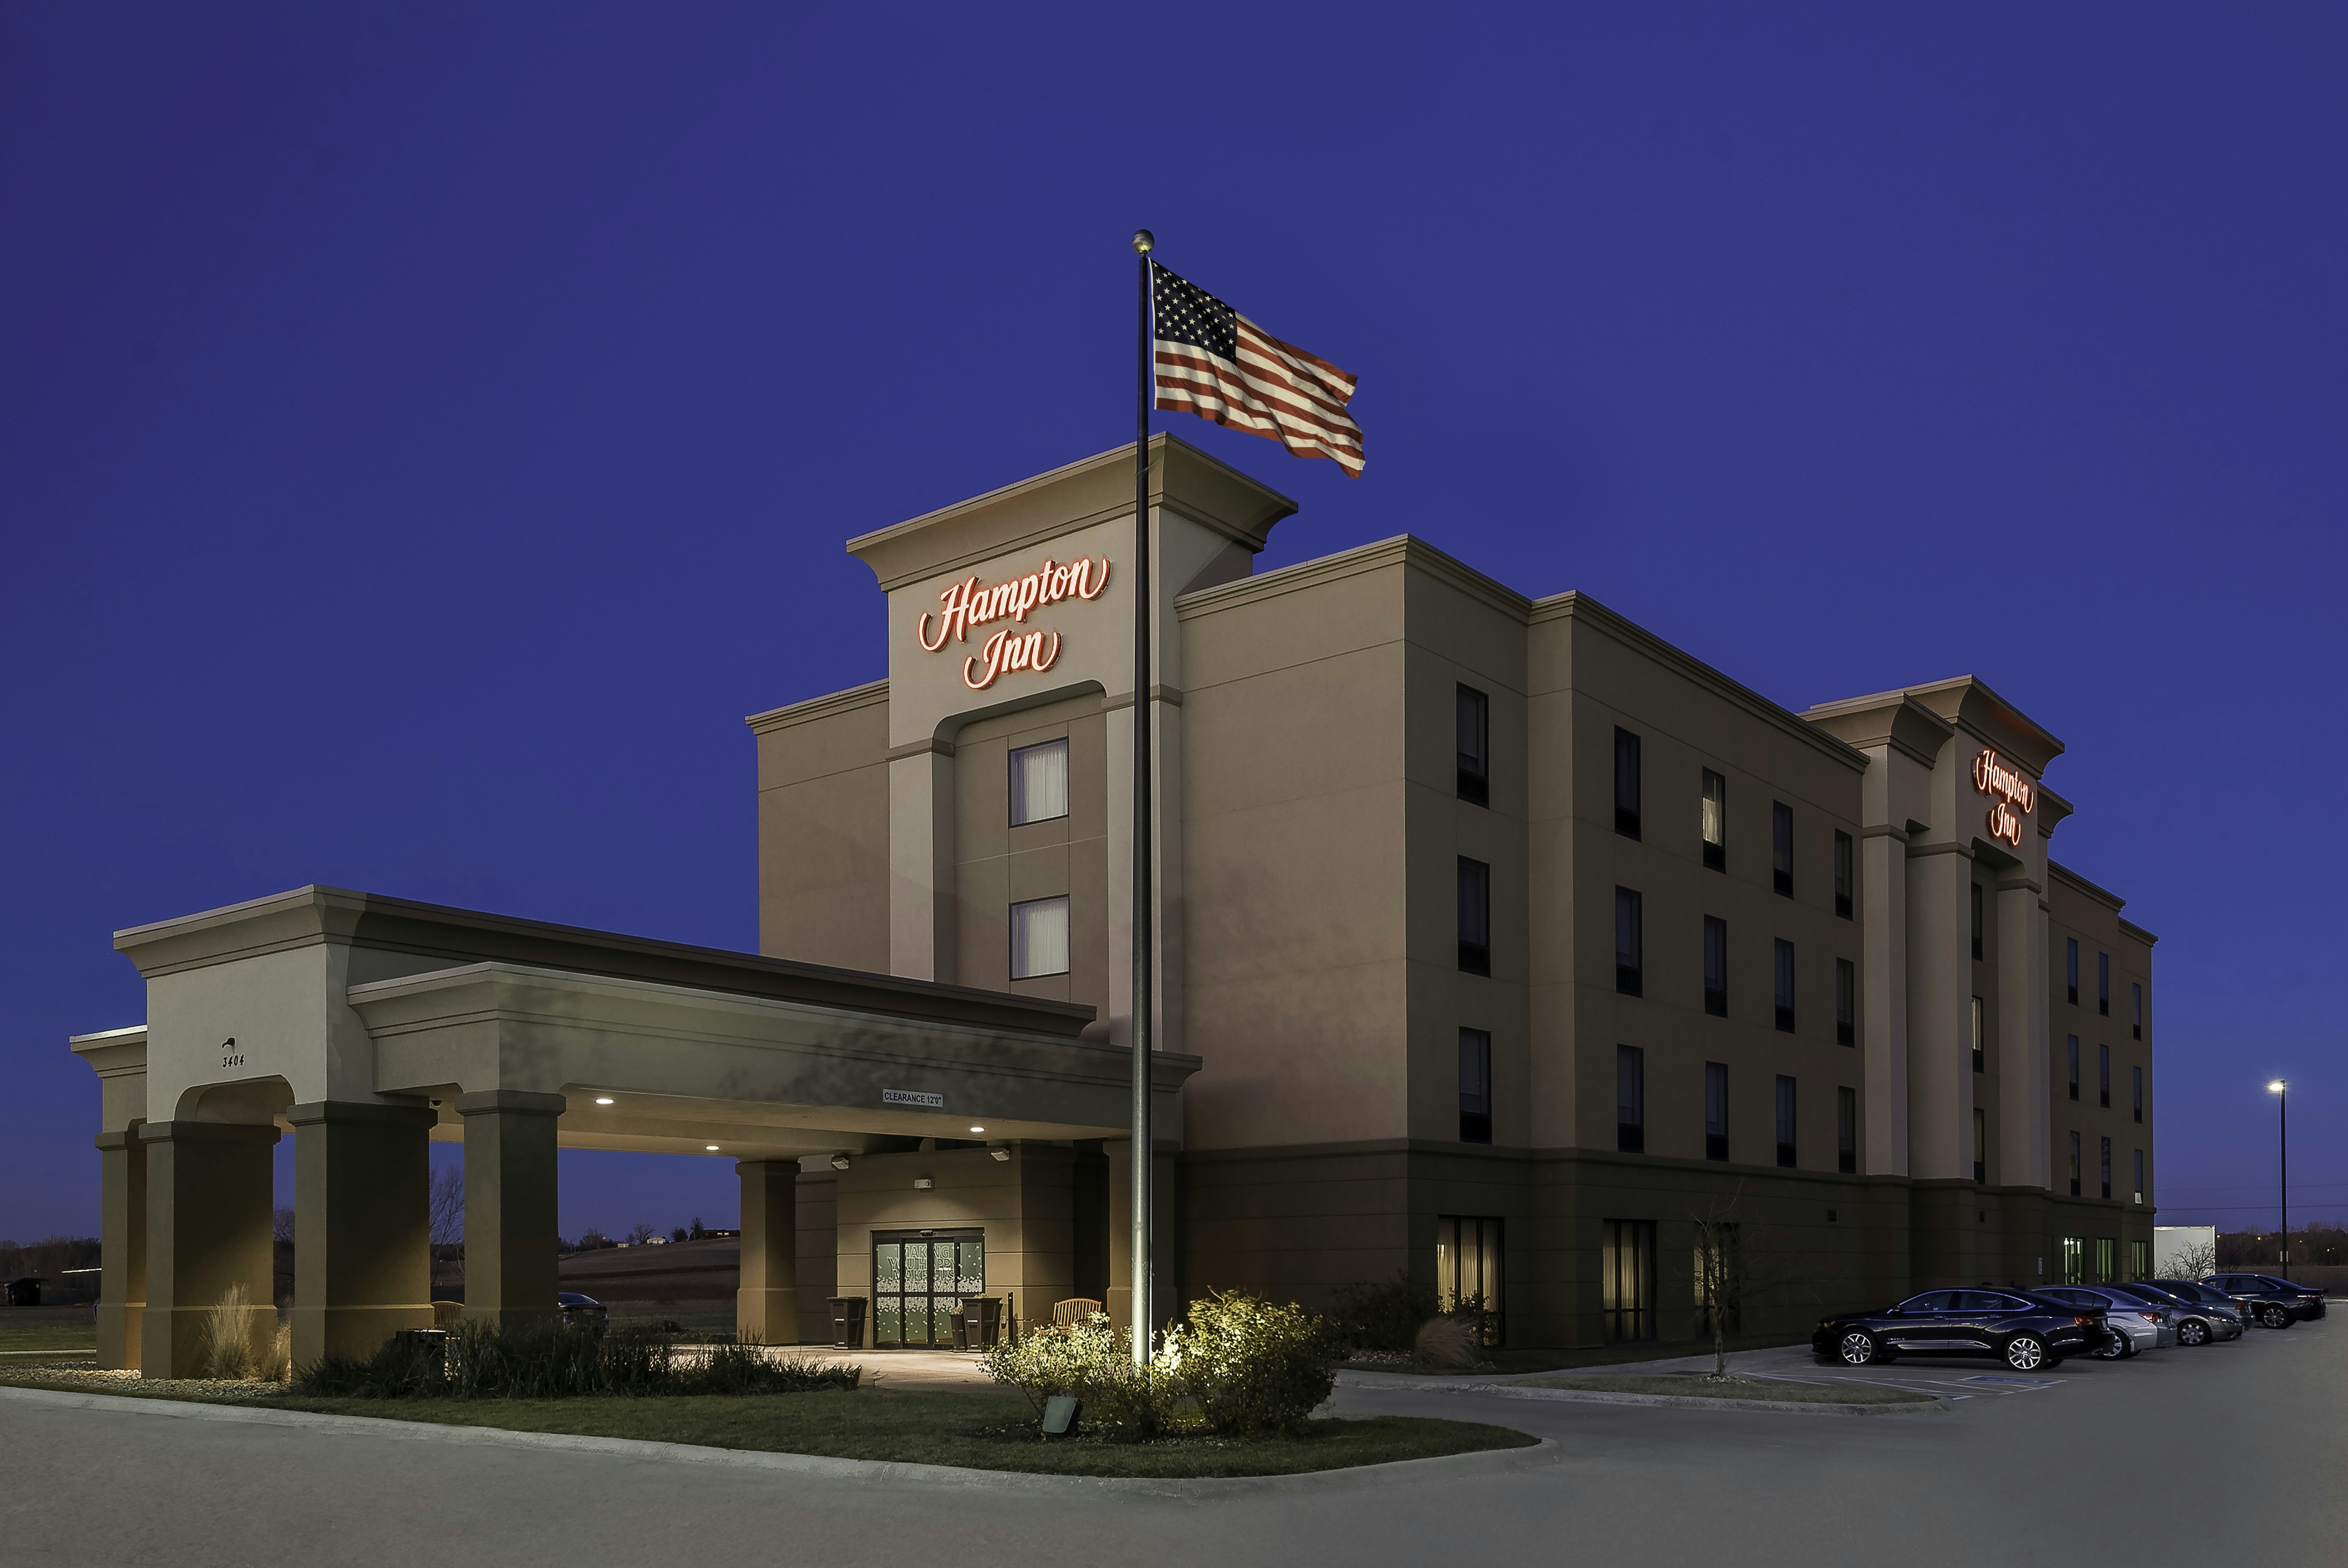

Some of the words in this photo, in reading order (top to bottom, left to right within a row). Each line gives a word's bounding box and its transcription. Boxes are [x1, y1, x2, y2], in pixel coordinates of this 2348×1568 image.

[919, 557, 1110, 652] Hampton
[963, 628, 1062, 689] Inn
[1975, 749, 2034, 814] Hampton
[1991, 802, 2021, 846] Inn
[222, 1054, 244, 1067] 3404
[884, 1092, 925, 1103] CLEARANCE
[926, 1096, 942, 1104] 12'0"
[905, 1246, 949, 1258] AKNG
[918, 1257, 955, 1270] HPP
[892, 1269, 928, 1282] MAKE
